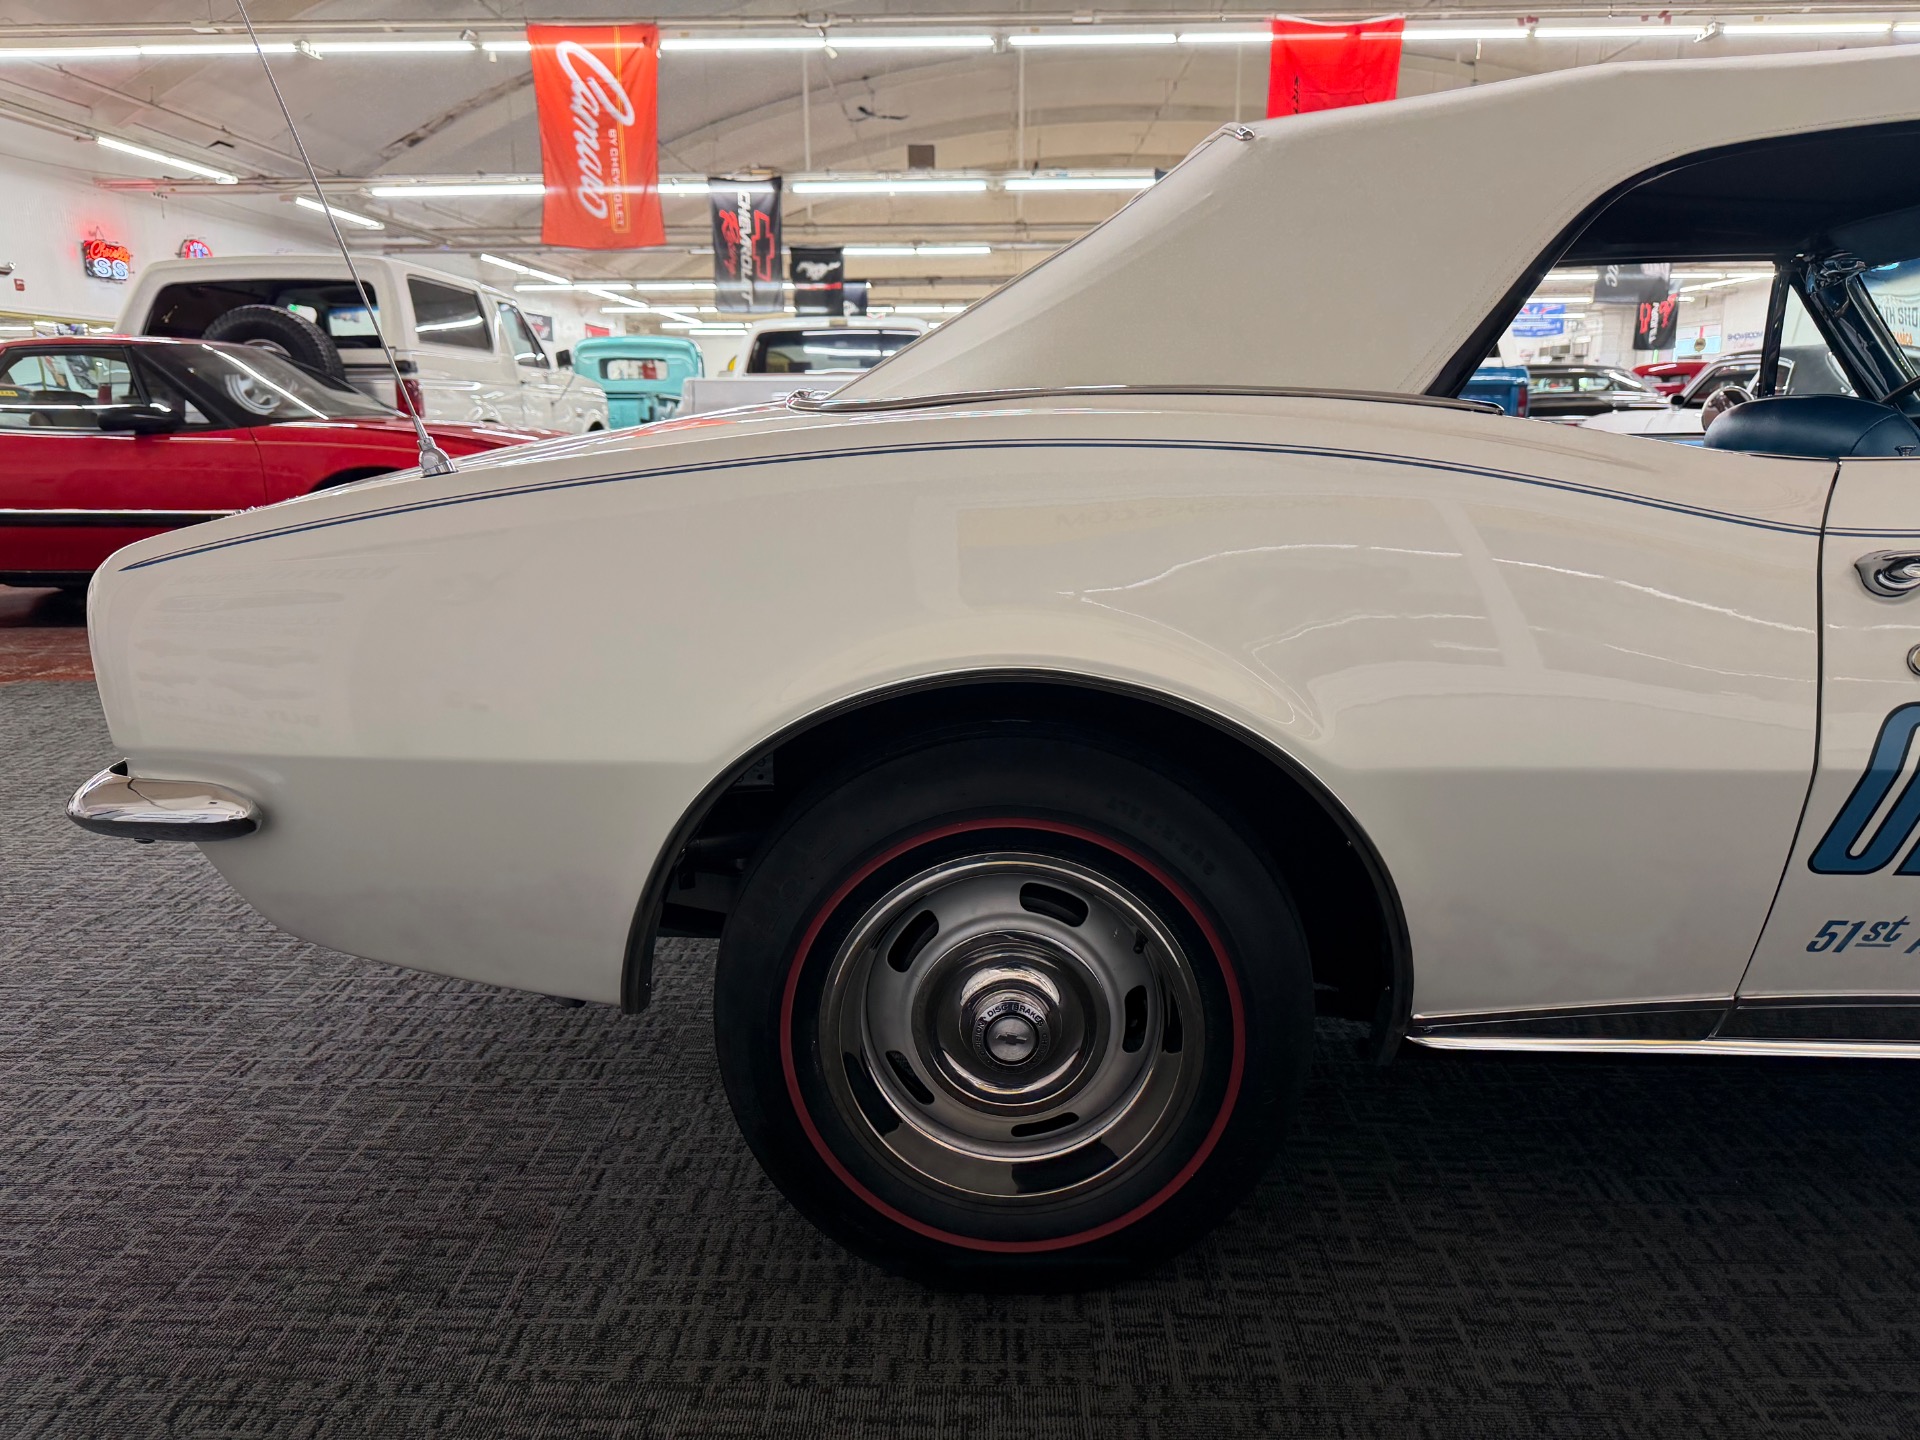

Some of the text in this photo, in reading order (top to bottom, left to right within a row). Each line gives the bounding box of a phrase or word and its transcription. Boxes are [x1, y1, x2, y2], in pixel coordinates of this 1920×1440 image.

[555, 41, 635, 220] Camaro
[607, 128, 618, 147] BY
[93, 257, 129, 280] SS
[1897, 306, 1920, 328] SHO
[1806, 916, 1911, 953] 51st
[987, 1004, 1008, 1018] DISC
